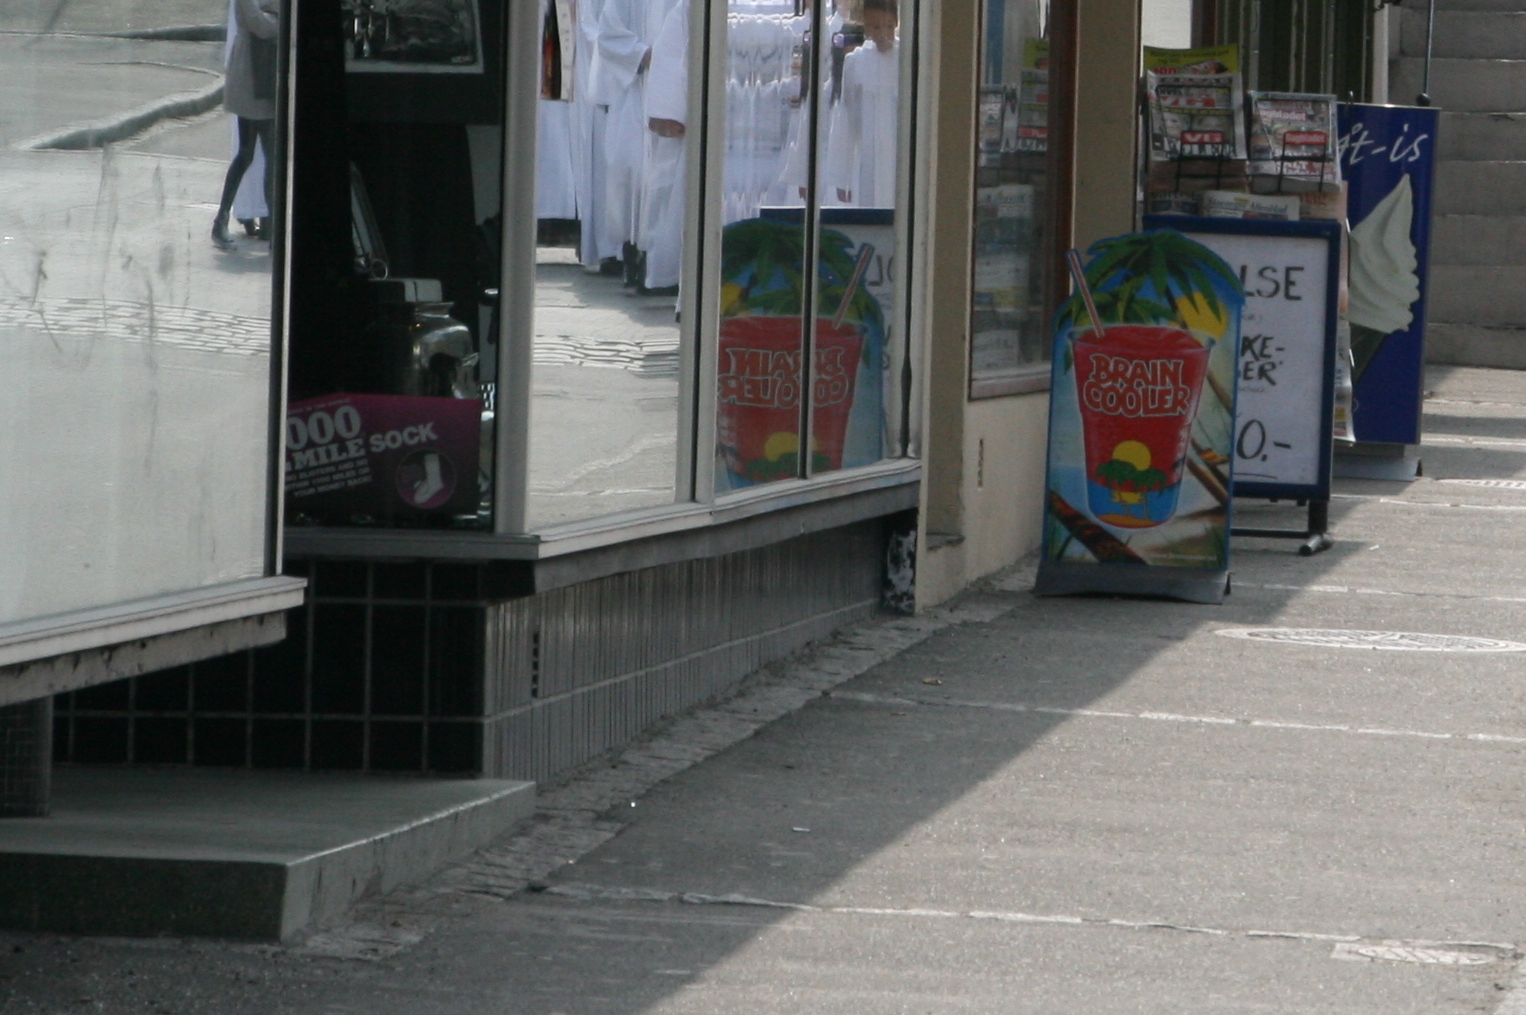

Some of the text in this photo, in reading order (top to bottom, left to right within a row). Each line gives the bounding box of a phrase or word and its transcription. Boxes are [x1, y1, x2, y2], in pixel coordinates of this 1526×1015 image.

[1089, 353, 1184, 387] BRAIN
[1083, 379, 1191, 418] COOLER
[369, 422, 439, 453] SOCK
